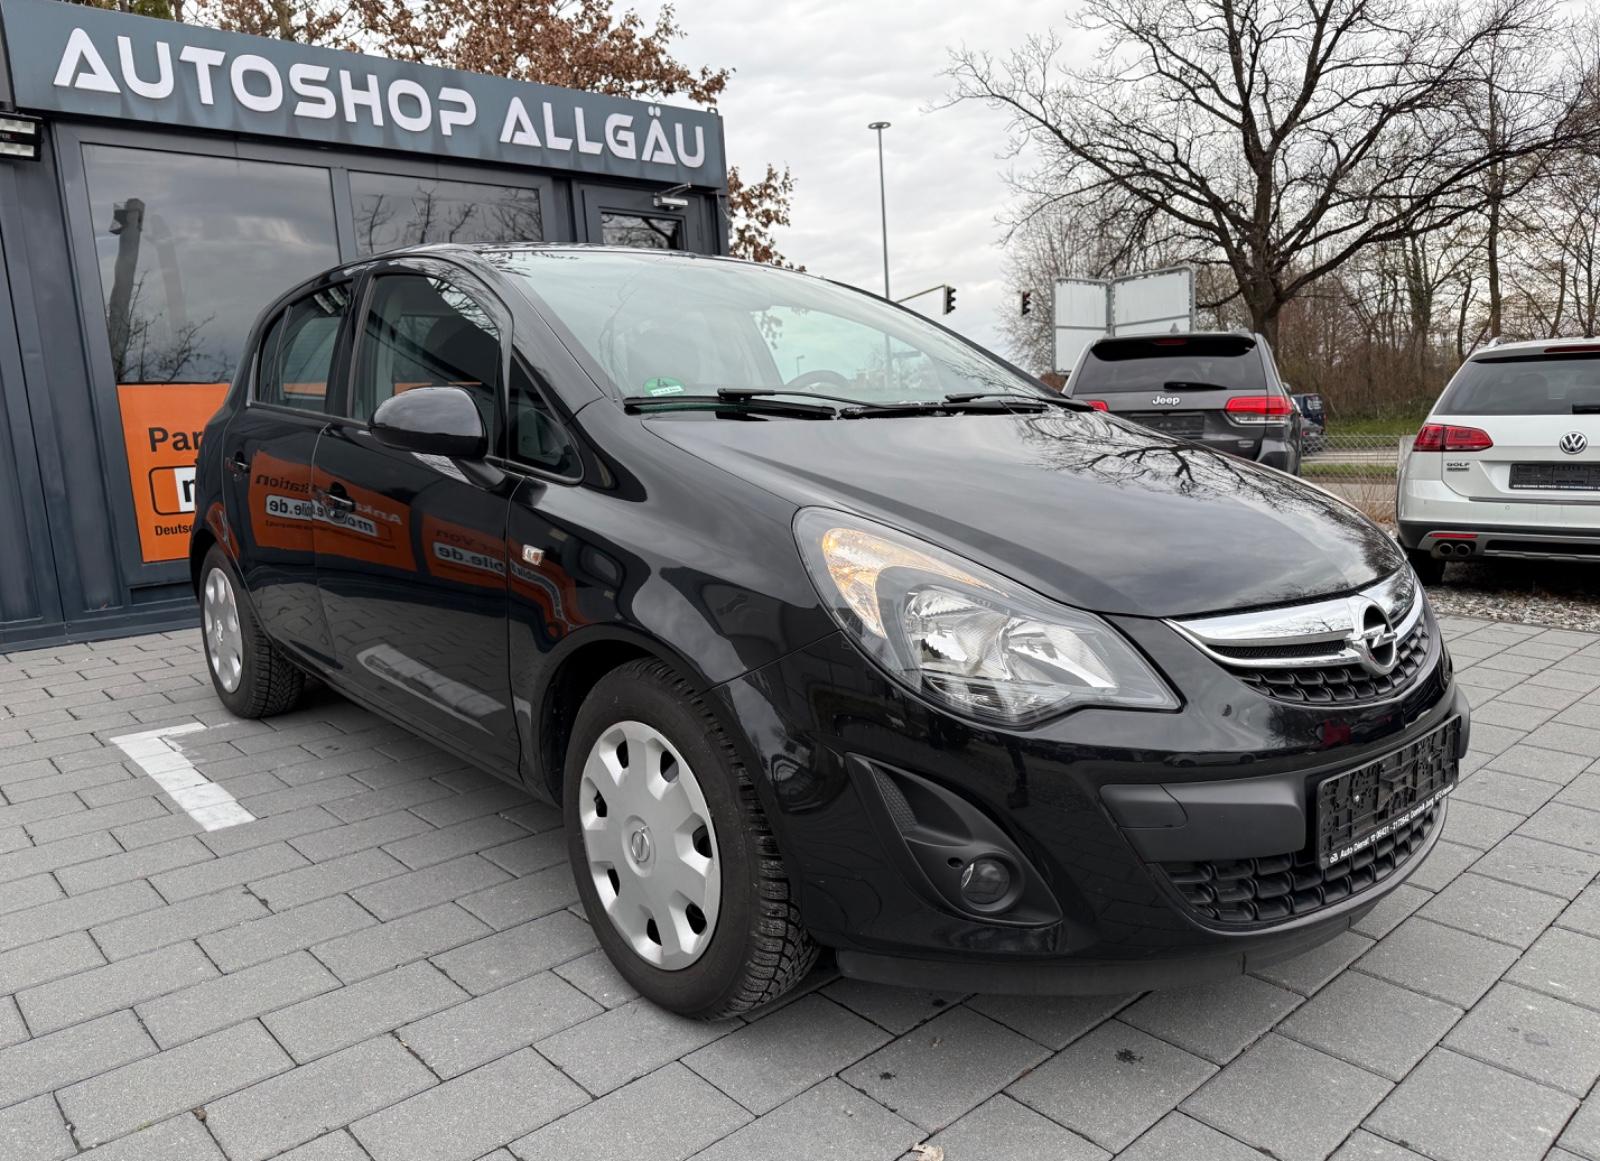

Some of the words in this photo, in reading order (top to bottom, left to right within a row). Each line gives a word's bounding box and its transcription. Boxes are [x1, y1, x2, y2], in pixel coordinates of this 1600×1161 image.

[54, 27, 477, 136] AUTOSHOP
[500, 97, 704, 168] ALLGÄU
[1152, 395, 1180, 405] Jeep
